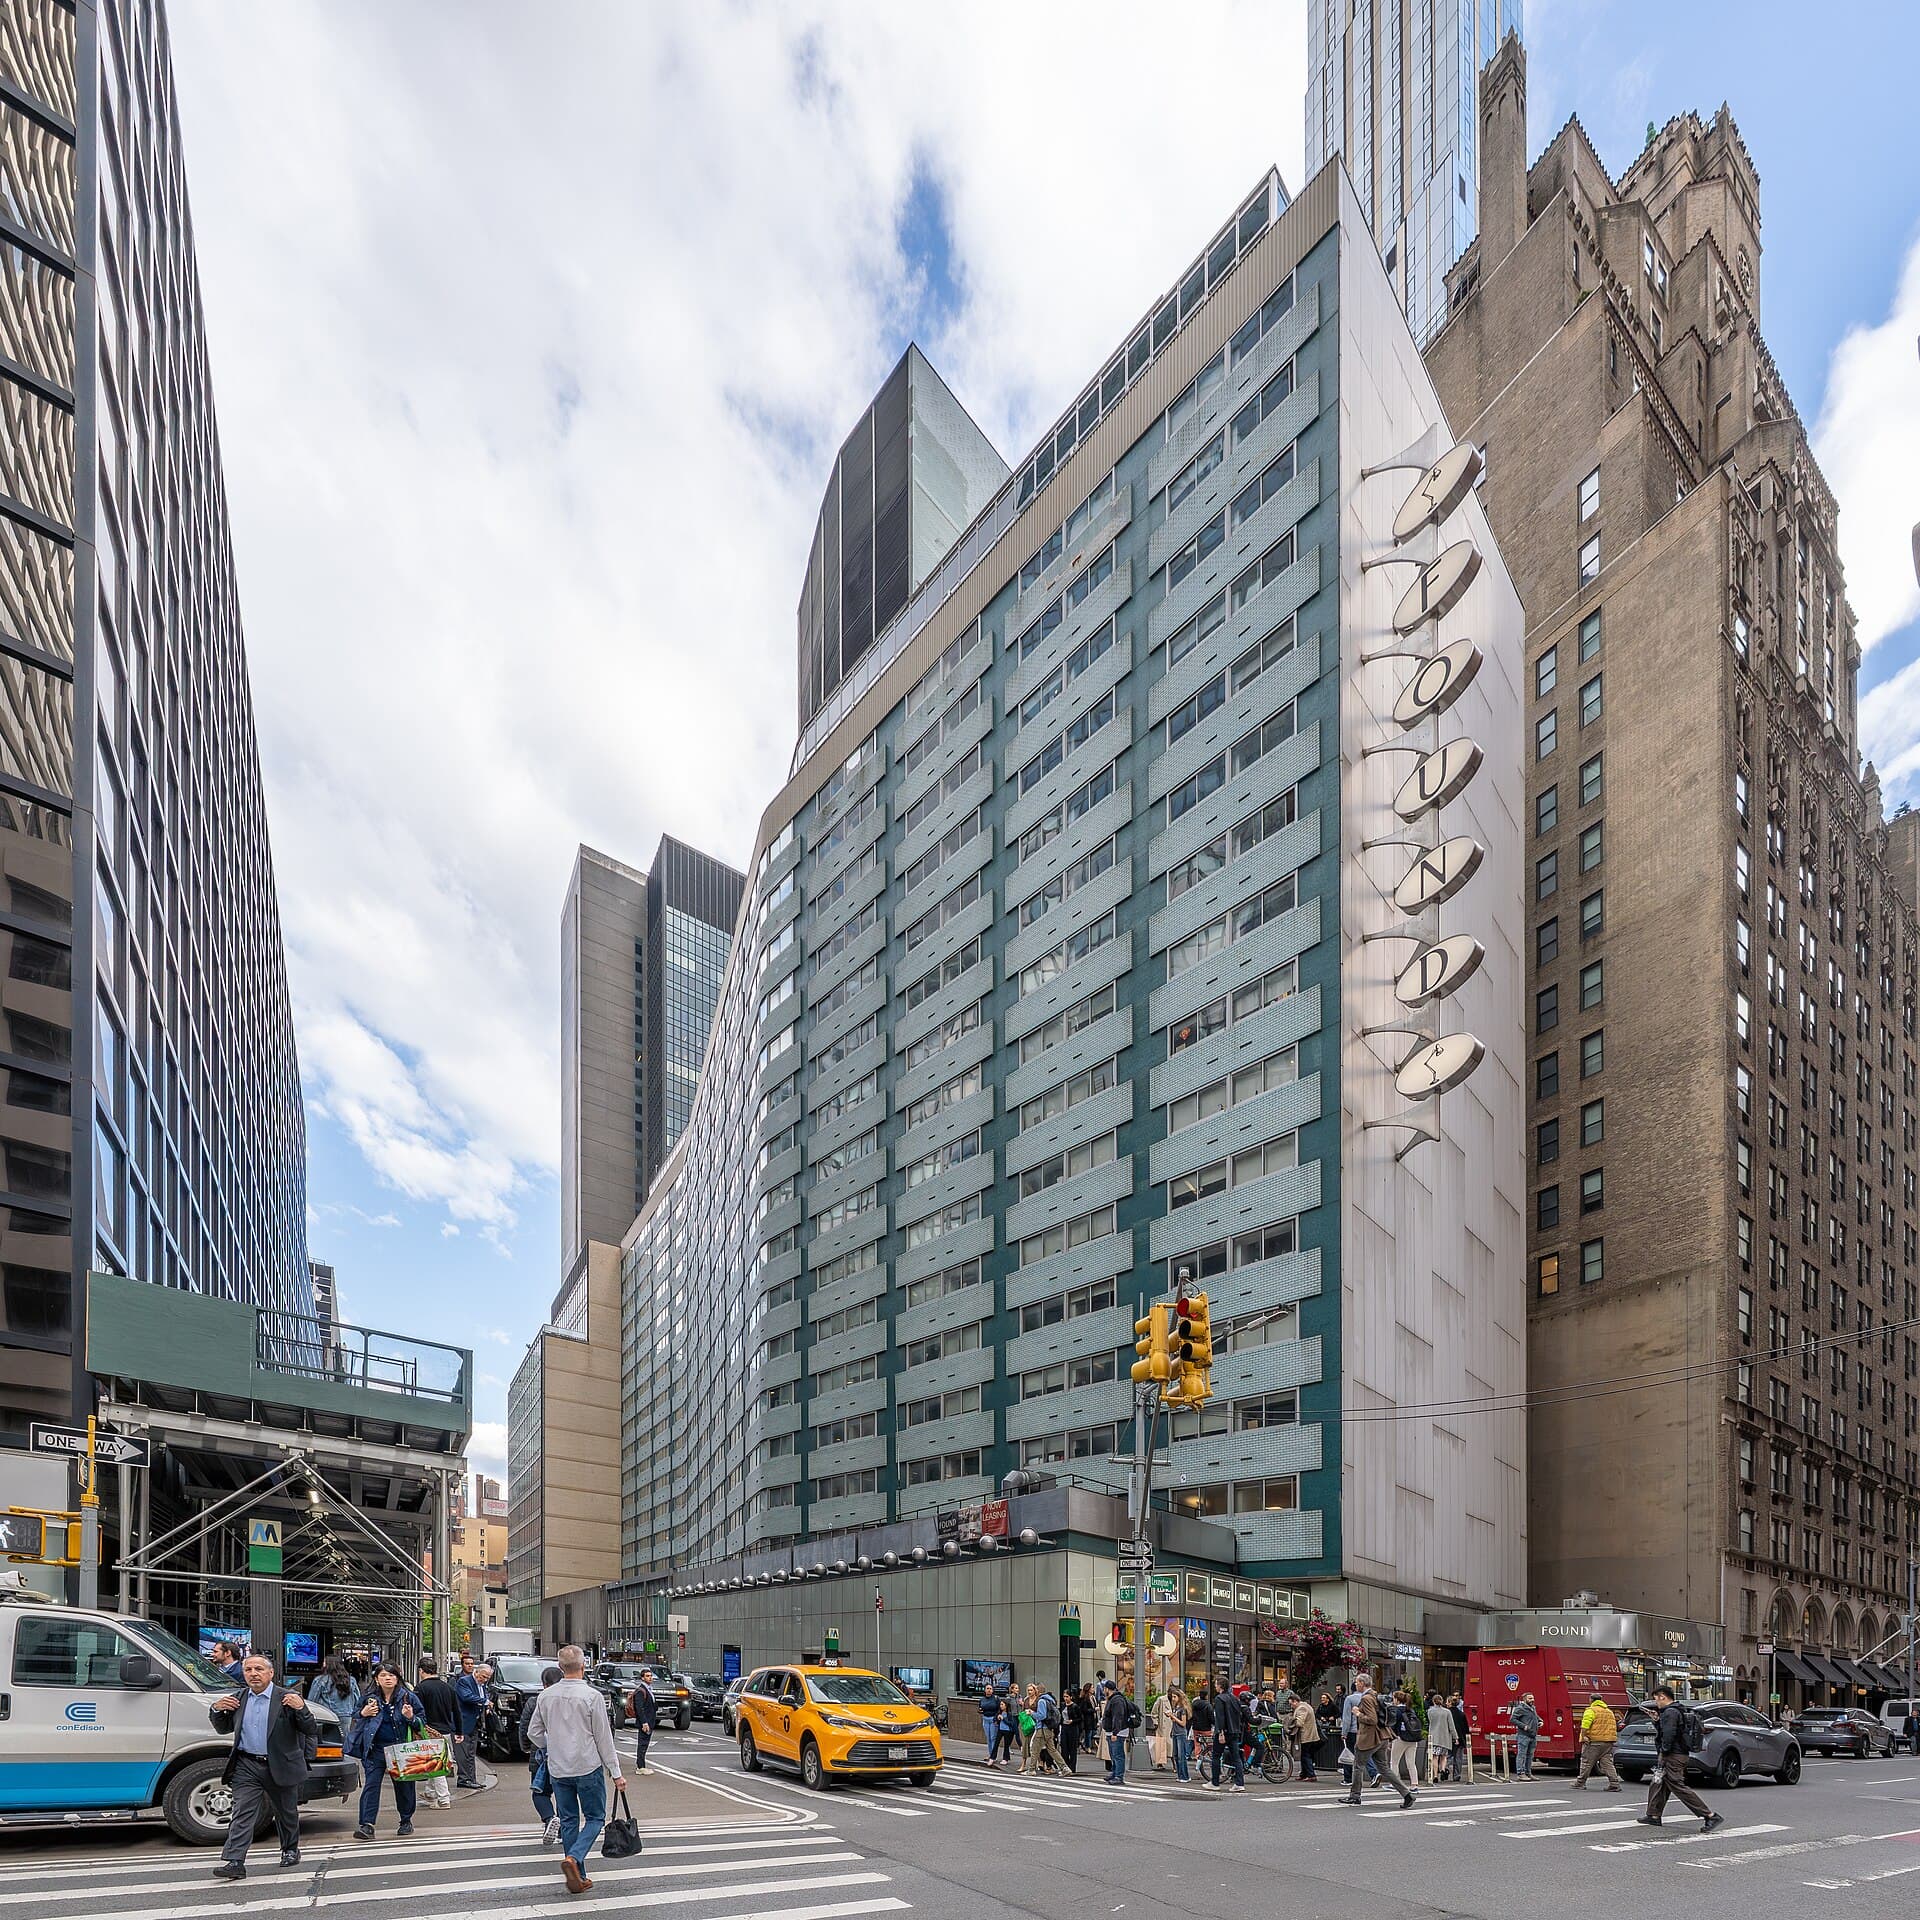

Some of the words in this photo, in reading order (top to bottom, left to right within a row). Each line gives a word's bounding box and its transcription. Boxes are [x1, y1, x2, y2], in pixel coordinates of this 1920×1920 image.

[45, 1434, 77, 1449] ONE
[94, 1440, 127, 1455] WAY
[987, 1502, 1001, 1511] NOW
[982, 1510, 1007, 1521] LEASING
[1541, 1625, 1589, 1636] FOUND
[1664, 1630, 1685, 1643] FOUND
[1513, 1658, 1526, 1666] L-2
[1496, 1706, 1515, 1715] FI
